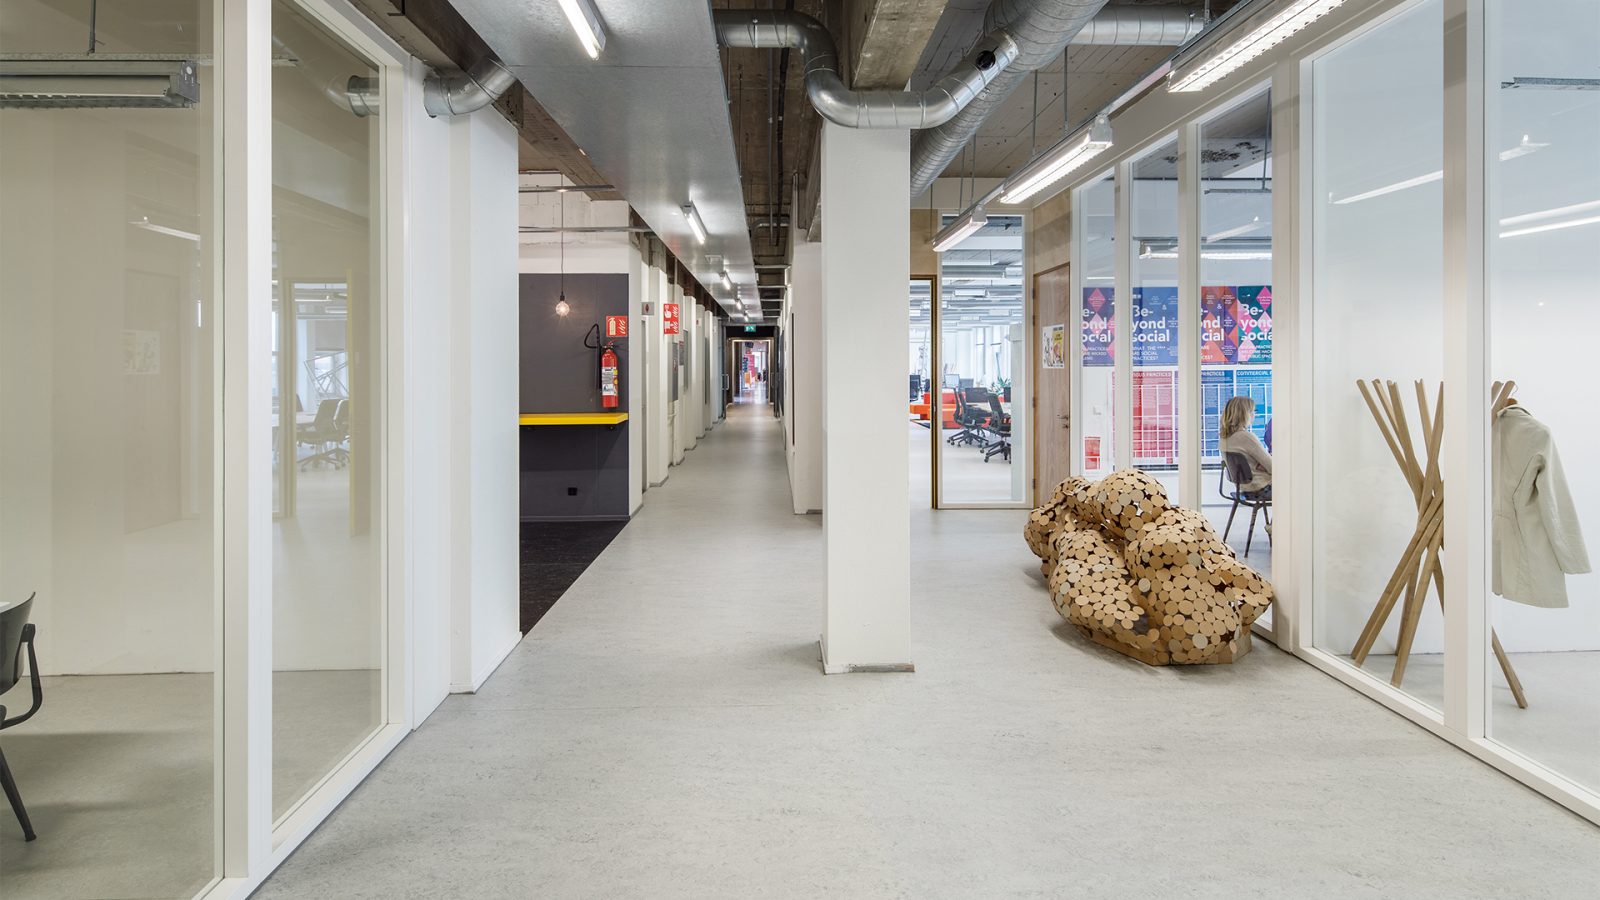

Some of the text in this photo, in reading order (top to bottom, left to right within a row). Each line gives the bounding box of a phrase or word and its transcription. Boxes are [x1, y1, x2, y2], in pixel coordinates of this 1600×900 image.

[1082, 316, 1107, 330] ond
[1132, 316, 1166, 332] yond
[1132, 329, 1170, 342] social
[1202, 328, 1224, 341] cial
